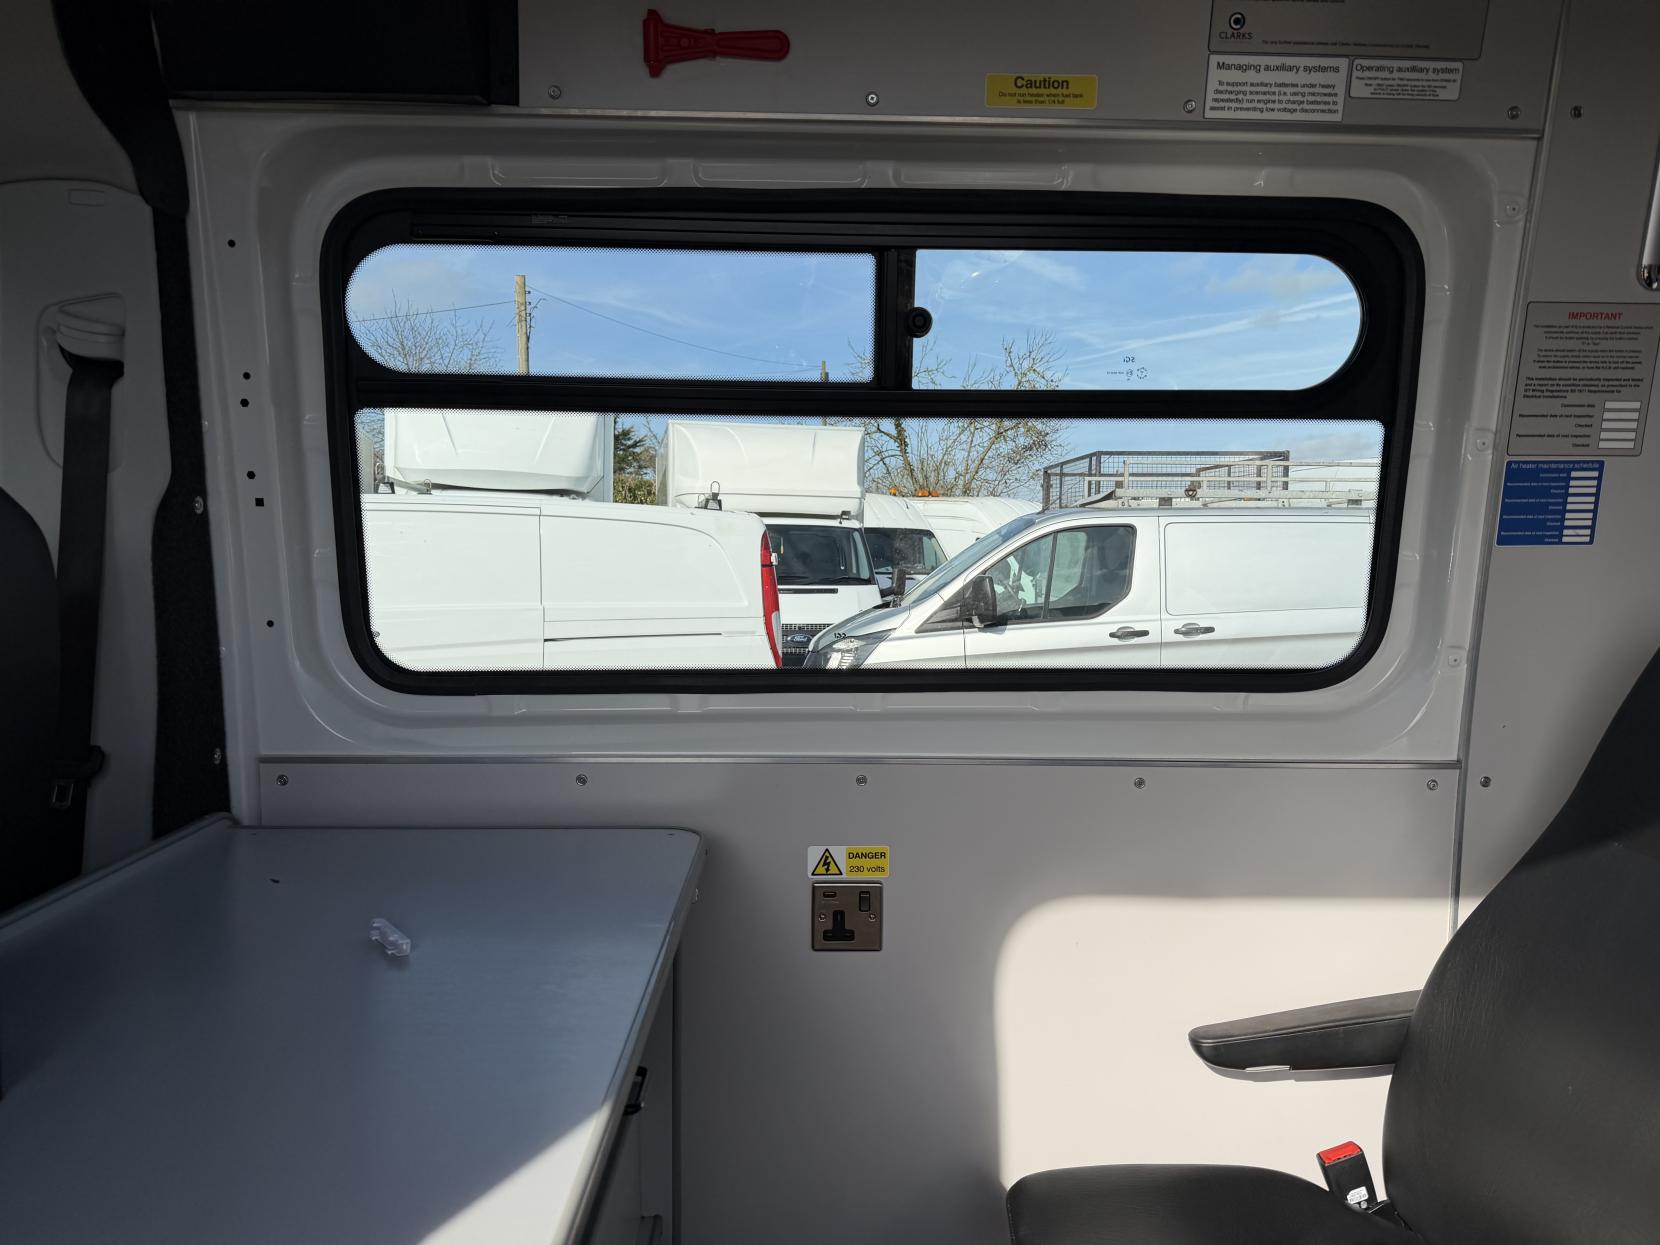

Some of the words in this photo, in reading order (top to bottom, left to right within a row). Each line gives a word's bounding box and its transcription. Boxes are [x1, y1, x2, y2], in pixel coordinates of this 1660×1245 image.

[1219, 32, 1254, 40] CLARKS
[1216, 61, 1261, 74] Managing
[1264, 63, 1300, 74] auxiliary
[1303, 64, 1340, 74] systems
[1355, 64, 1394, 74] Operating
[1432, 66, 1459, 75] system
[1014, 76, 1069, 89] Caution
[1568, 311, 1623, 321] IMPORTANT
